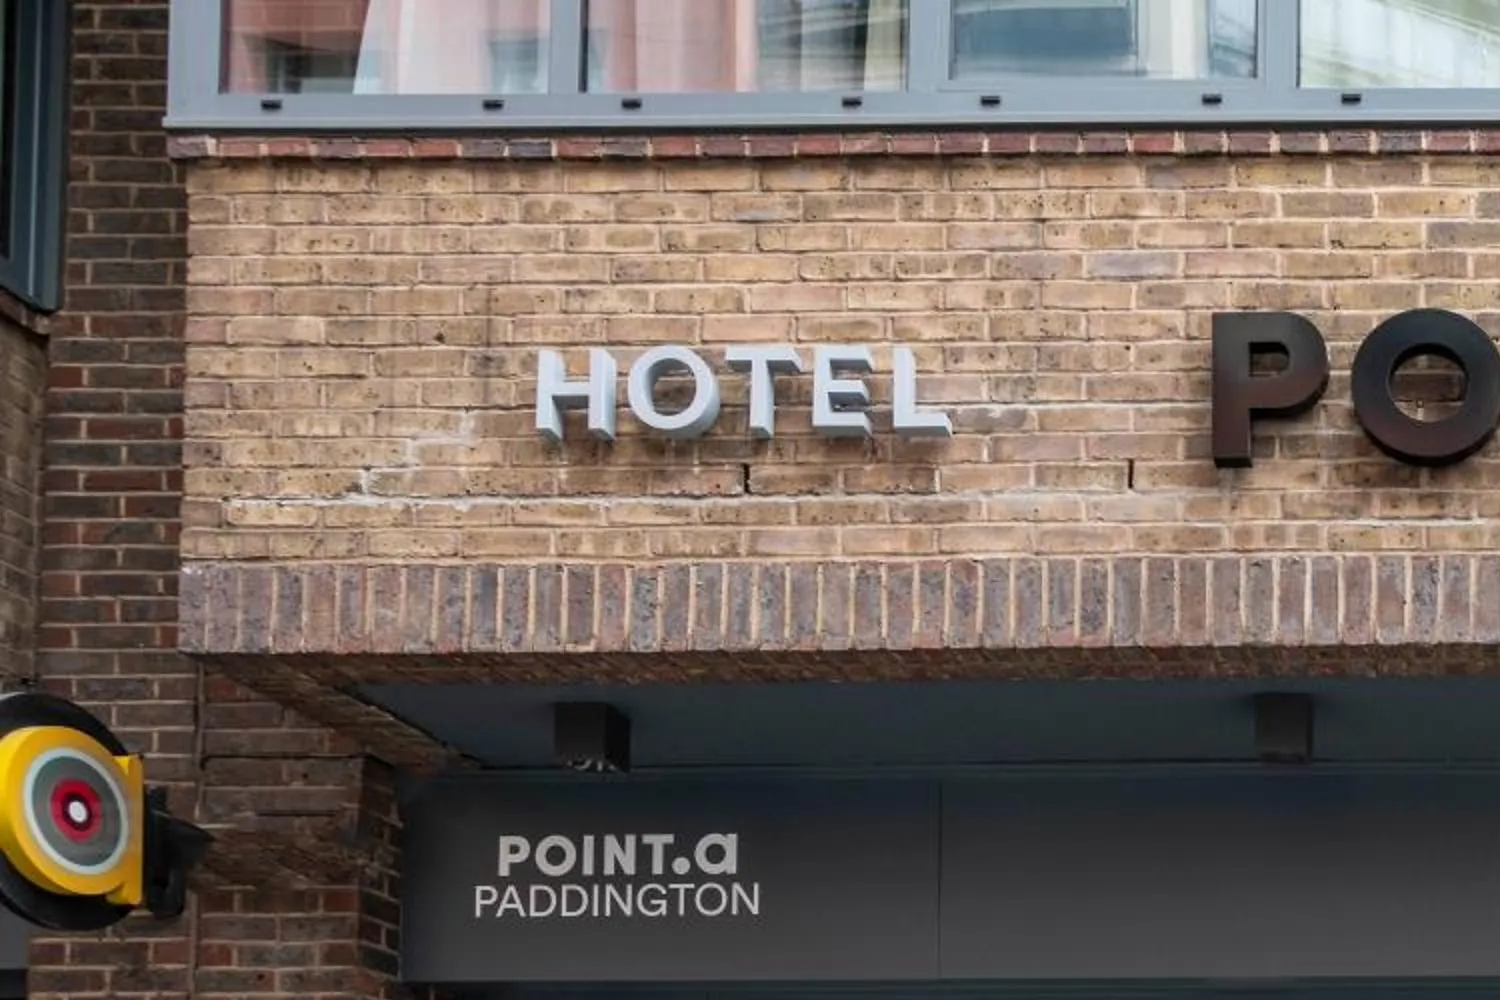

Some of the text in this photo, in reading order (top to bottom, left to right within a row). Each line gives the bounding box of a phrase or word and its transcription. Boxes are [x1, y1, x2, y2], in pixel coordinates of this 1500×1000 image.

[534, 345, 953, 441] HOTEL
[498, 833, 738, 877] POINT.a
[473, 882, 761, 918] PADDINGTON
